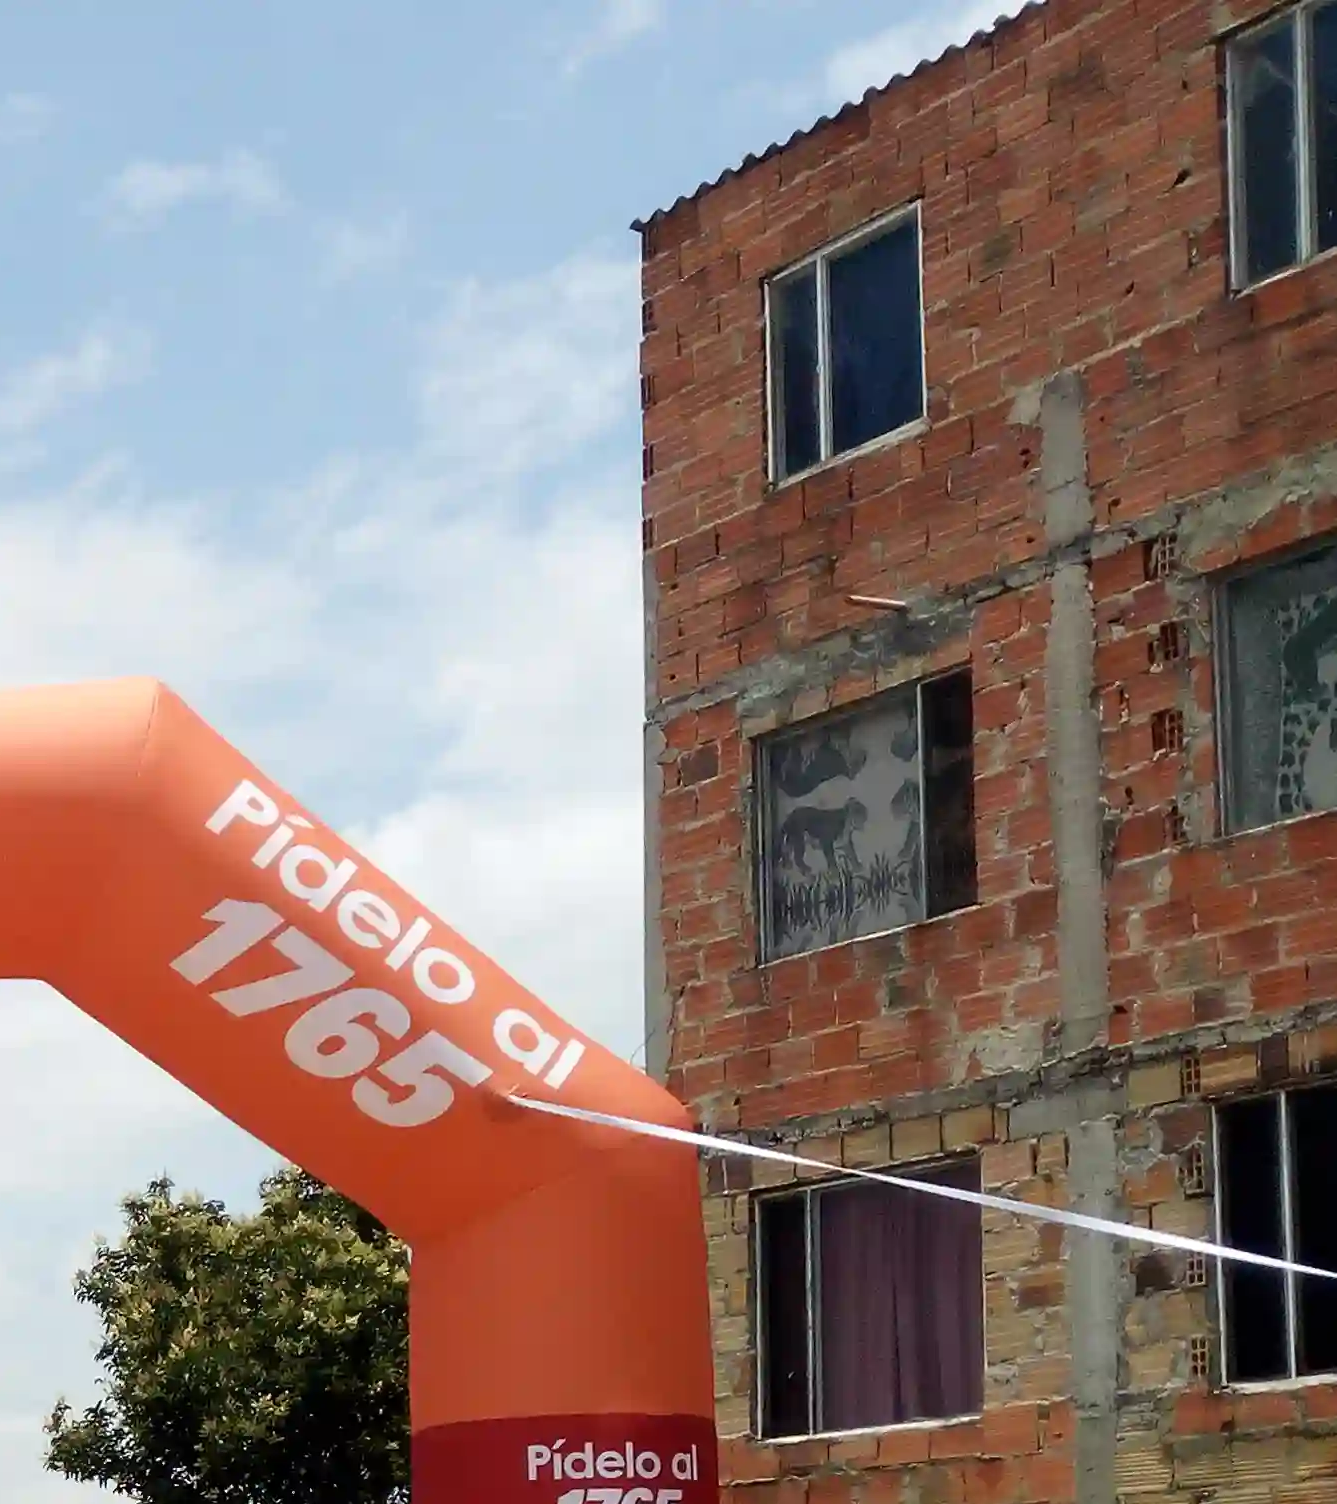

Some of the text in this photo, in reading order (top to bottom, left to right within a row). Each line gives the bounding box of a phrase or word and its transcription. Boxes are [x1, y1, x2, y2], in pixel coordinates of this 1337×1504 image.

[168, 897, 494, 1127] 1765
[203, 778, 586, 1090] Pídelo al
[527, 1438, 699, 1481] Pídelo al
